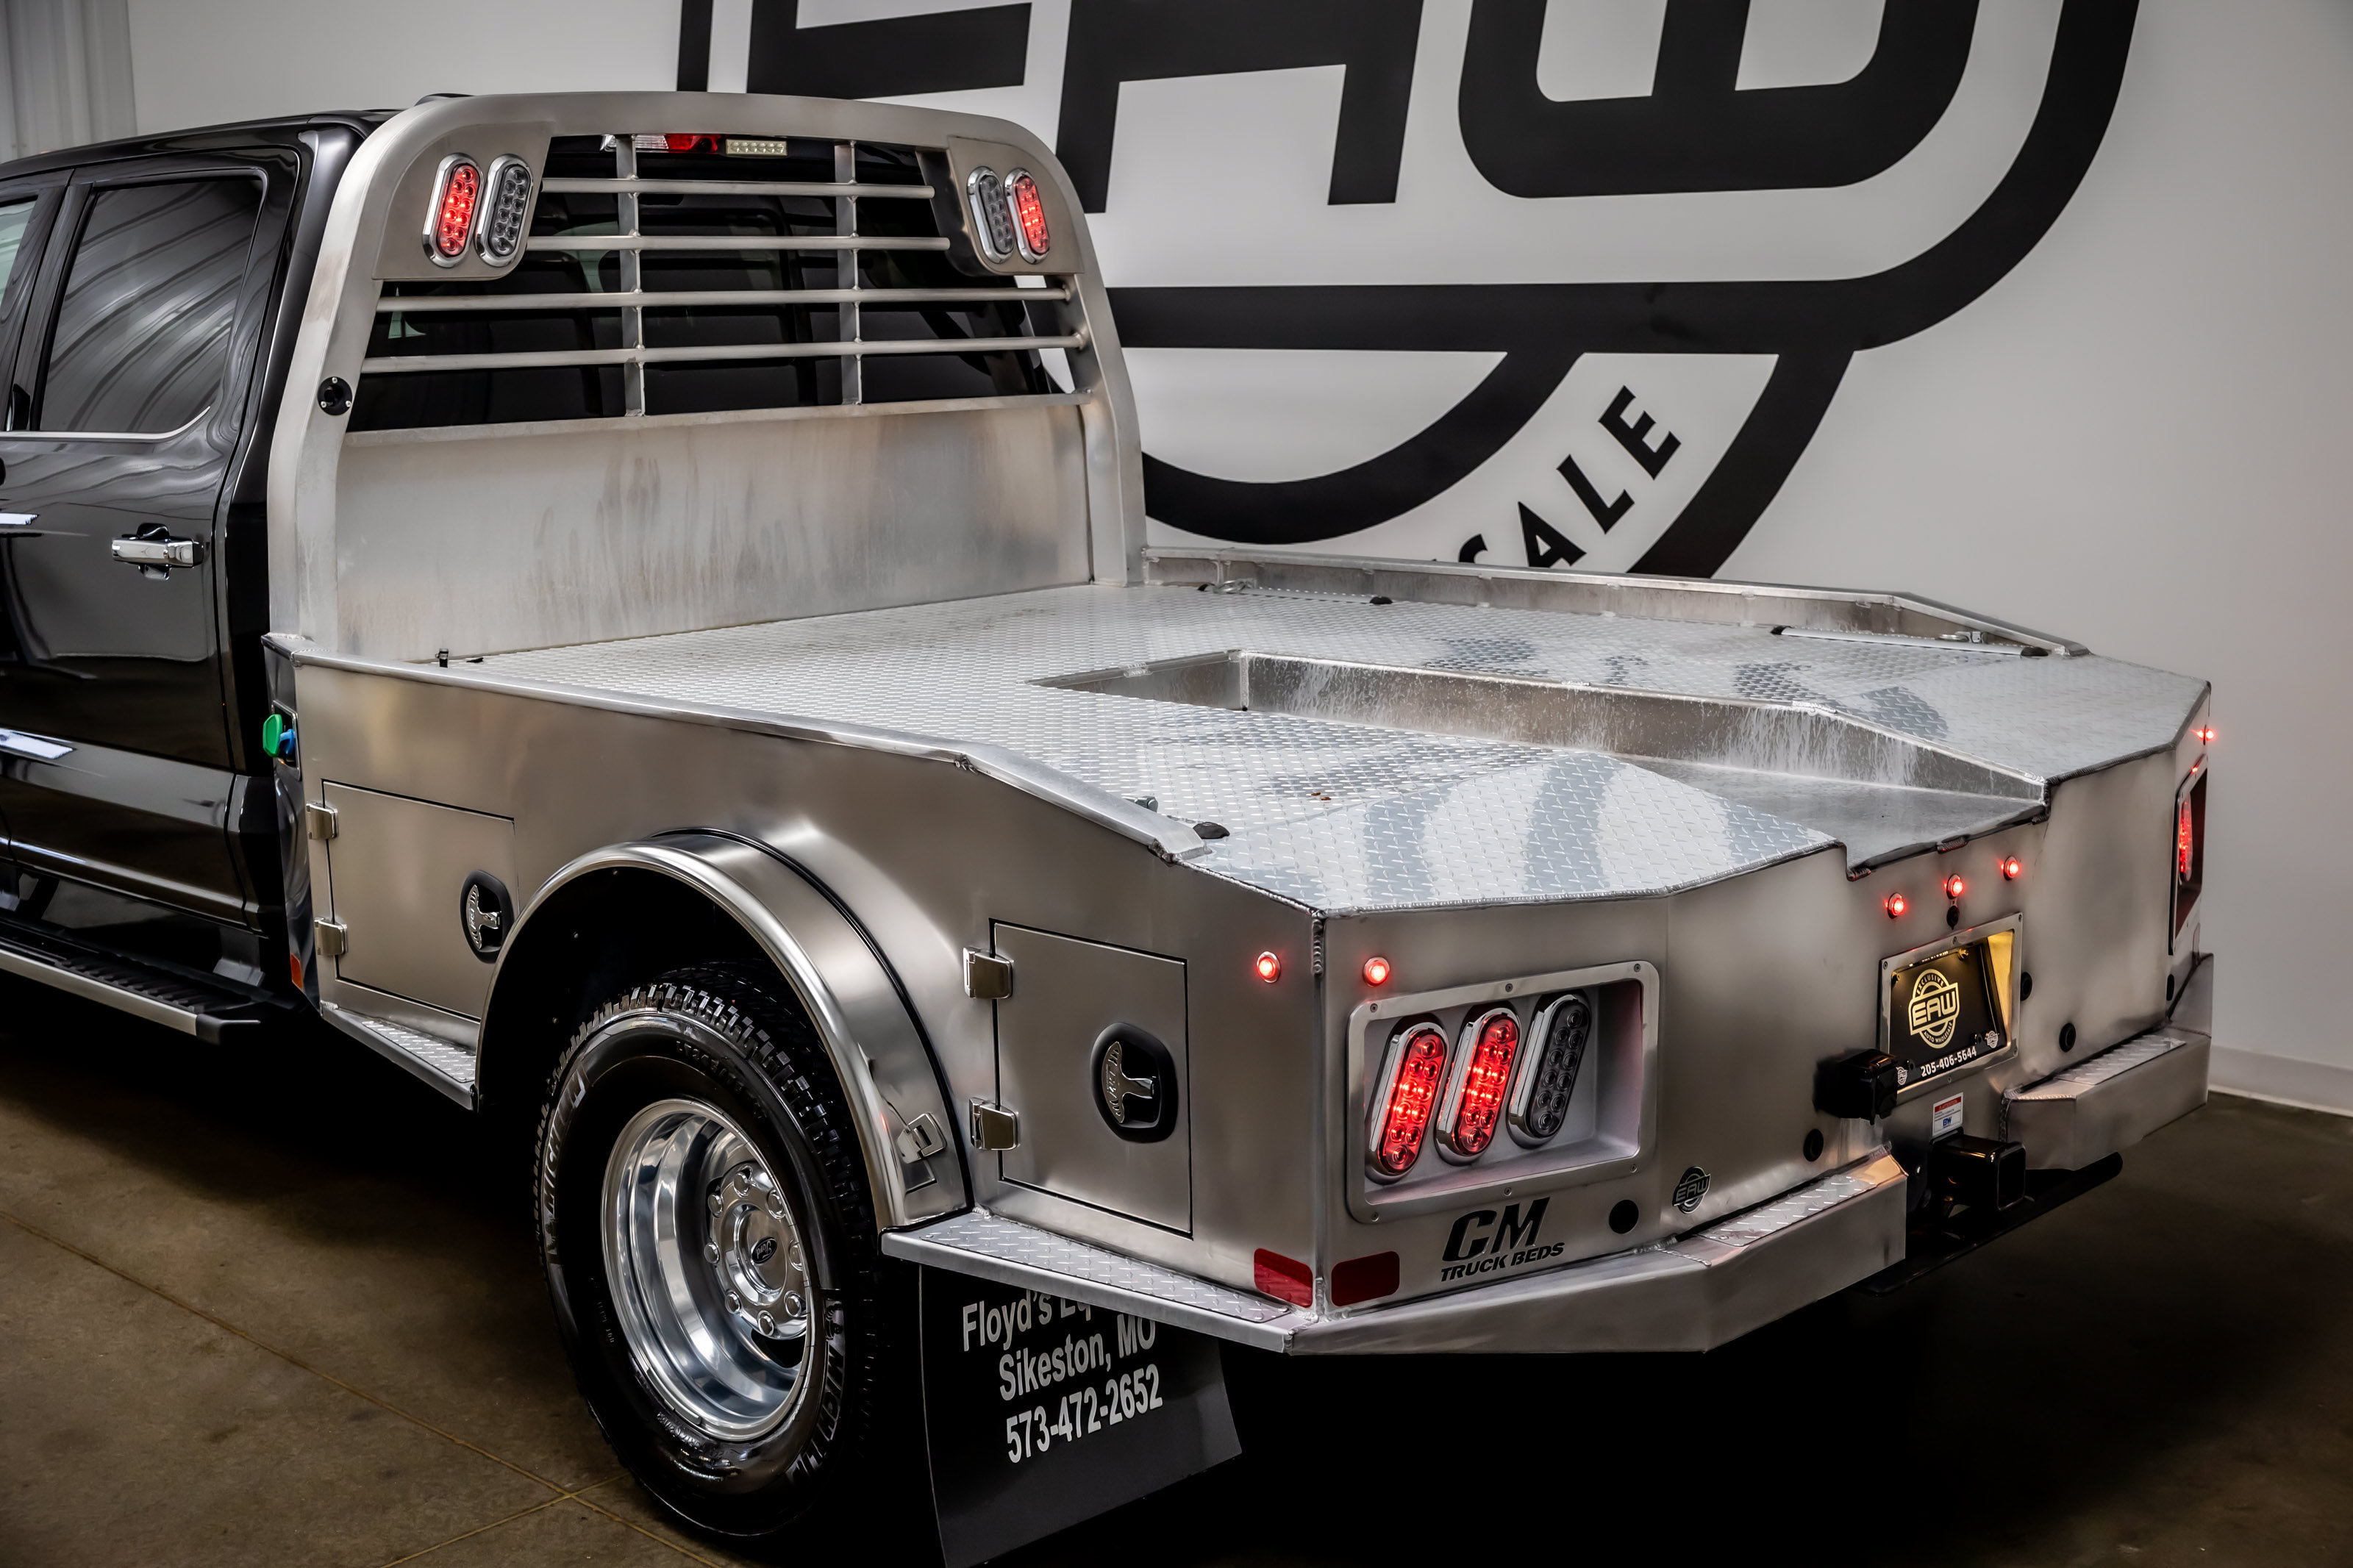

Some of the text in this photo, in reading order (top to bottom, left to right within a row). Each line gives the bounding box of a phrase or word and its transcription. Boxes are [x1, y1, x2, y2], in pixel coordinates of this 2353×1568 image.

[1912, 990, 1957, 1027] EAW
[1924, 1031, 1935, 1042] AUTO
[1920, 1046, 1977, 1077] 205-406-5644
[1676, 1178, 1708, 1202] EAW
[1442, 1197, 1551, 1262] CM
[756, 1240, 772, 1259] Ford
[1440, 1242, 1565, 1282] TRUCK BEDS
[963, 1290, 1053, 1352] Floyd's
[999, 1314, 1156, 1400] Sikeston, MO
[1006, 1364, 1163, 1464] 573-472-2652
